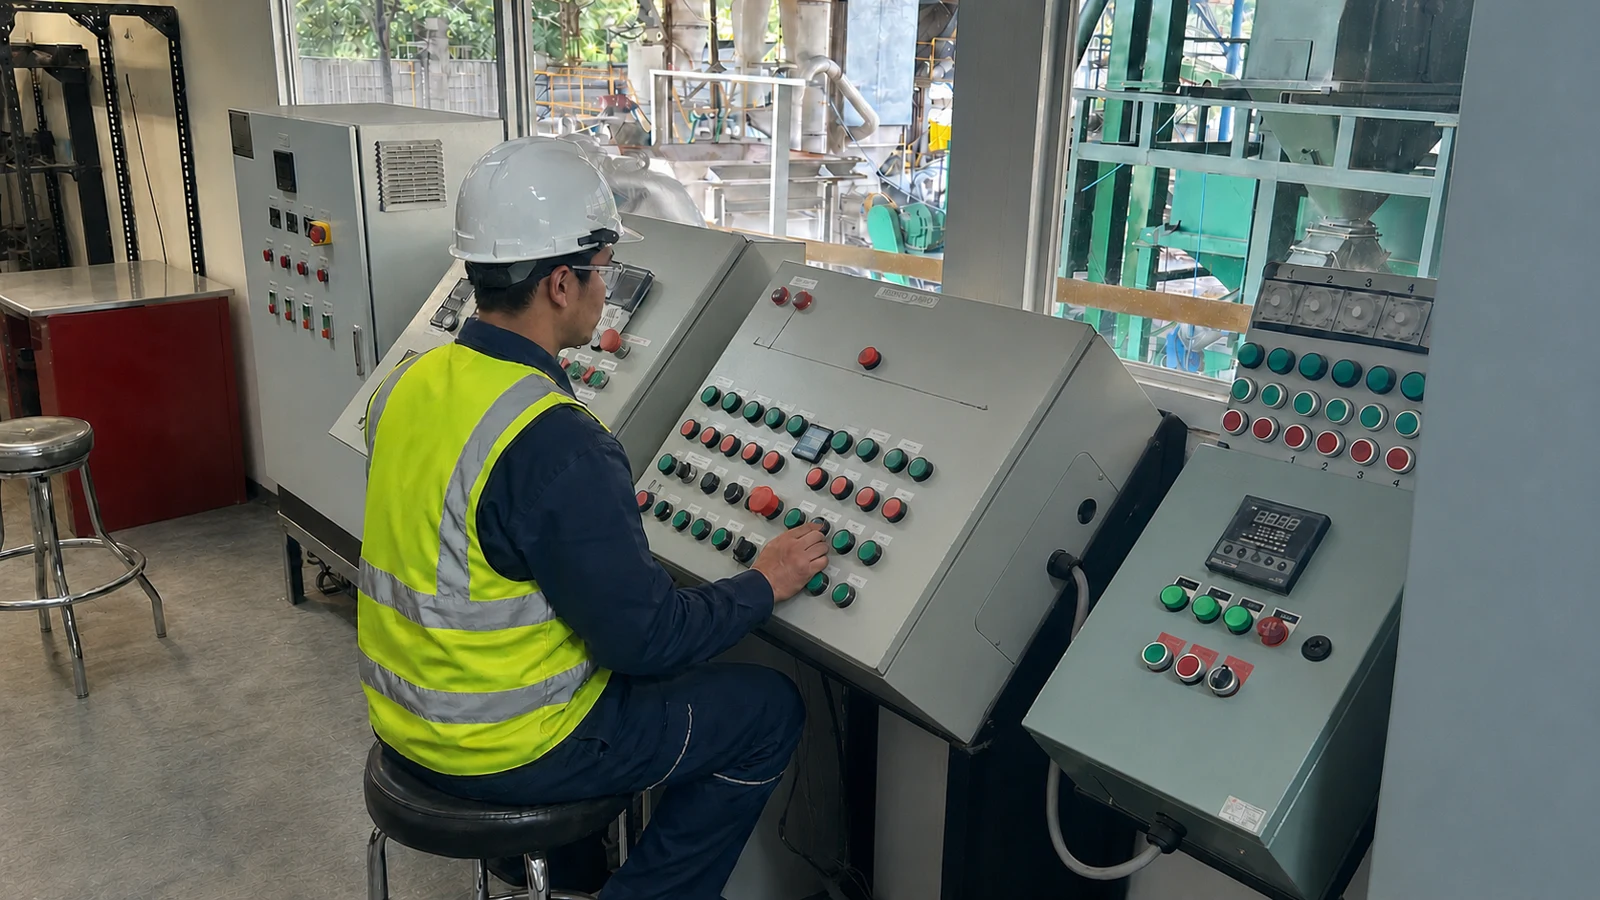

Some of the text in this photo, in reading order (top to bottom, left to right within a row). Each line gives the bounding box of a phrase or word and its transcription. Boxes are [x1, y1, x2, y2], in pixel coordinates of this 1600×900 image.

[1326, 275, 1334, 284] 2
[1365, 278, 1373, 288] 3
[1407, 283, 1415, 293] 4
[1290, 455, 1400, 488] 1 2 3 4
